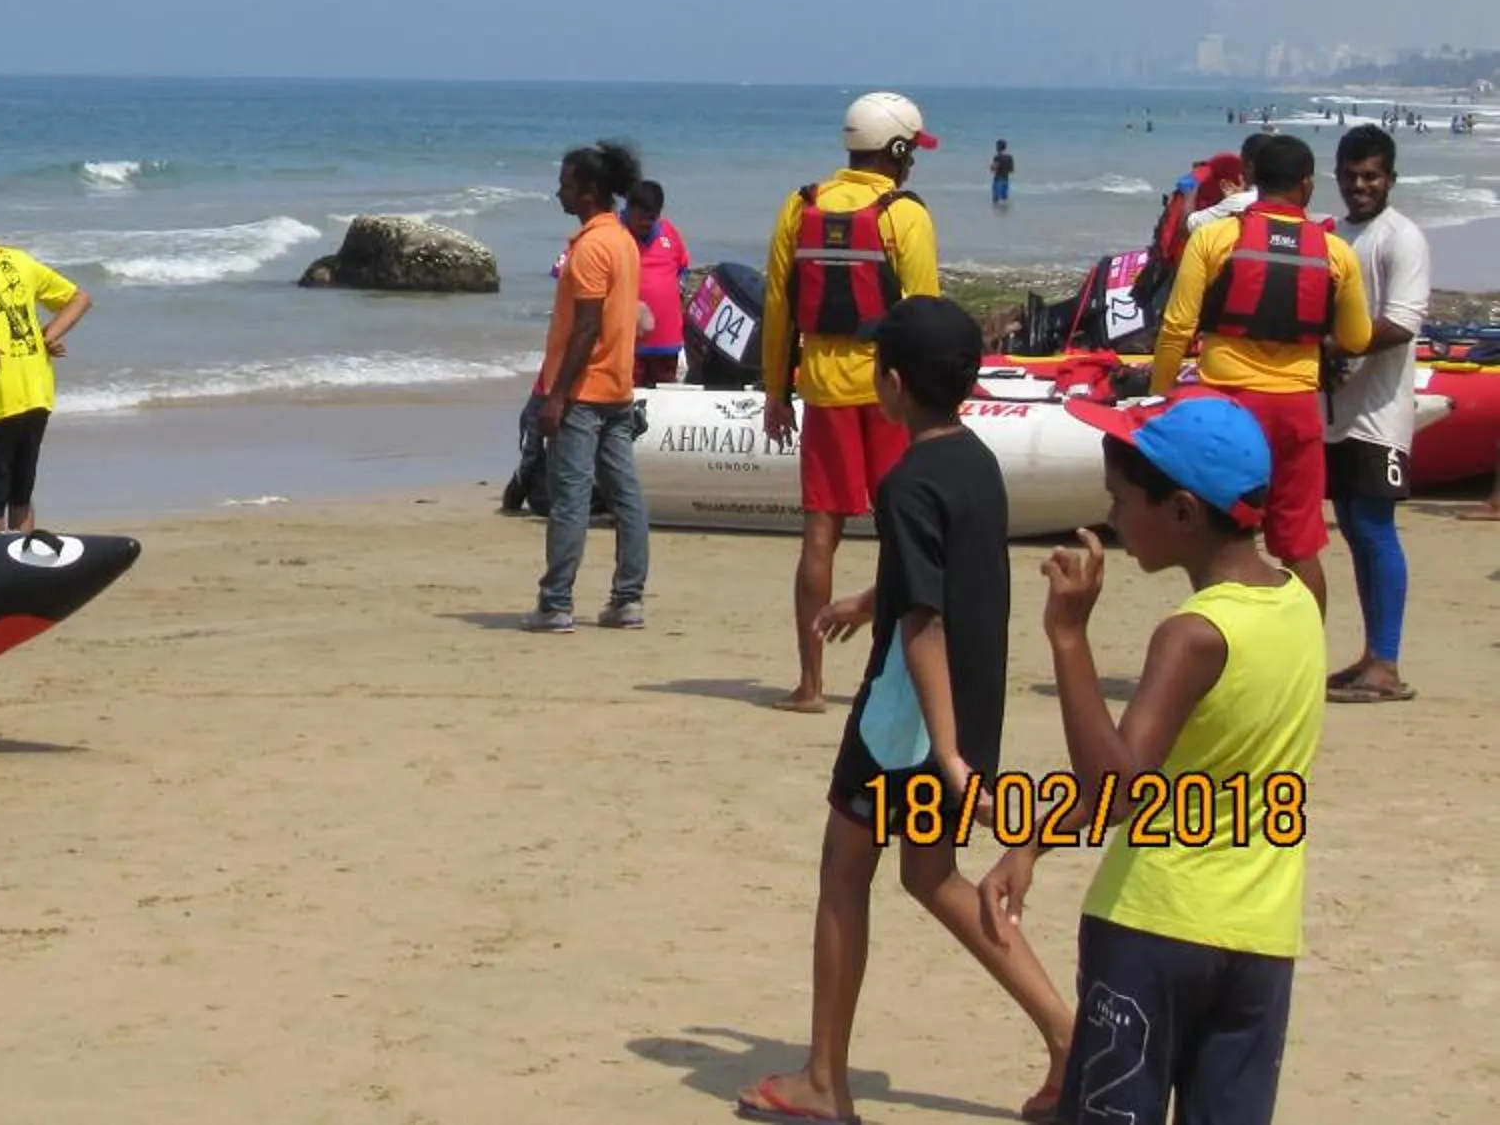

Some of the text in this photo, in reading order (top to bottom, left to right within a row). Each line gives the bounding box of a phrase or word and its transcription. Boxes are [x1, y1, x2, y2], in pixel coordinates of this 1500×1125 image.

[714, 304, 746, 345] 04
[959, 403, 1030, 418] LWA
[659, 426, 756, 454] AHMAD
